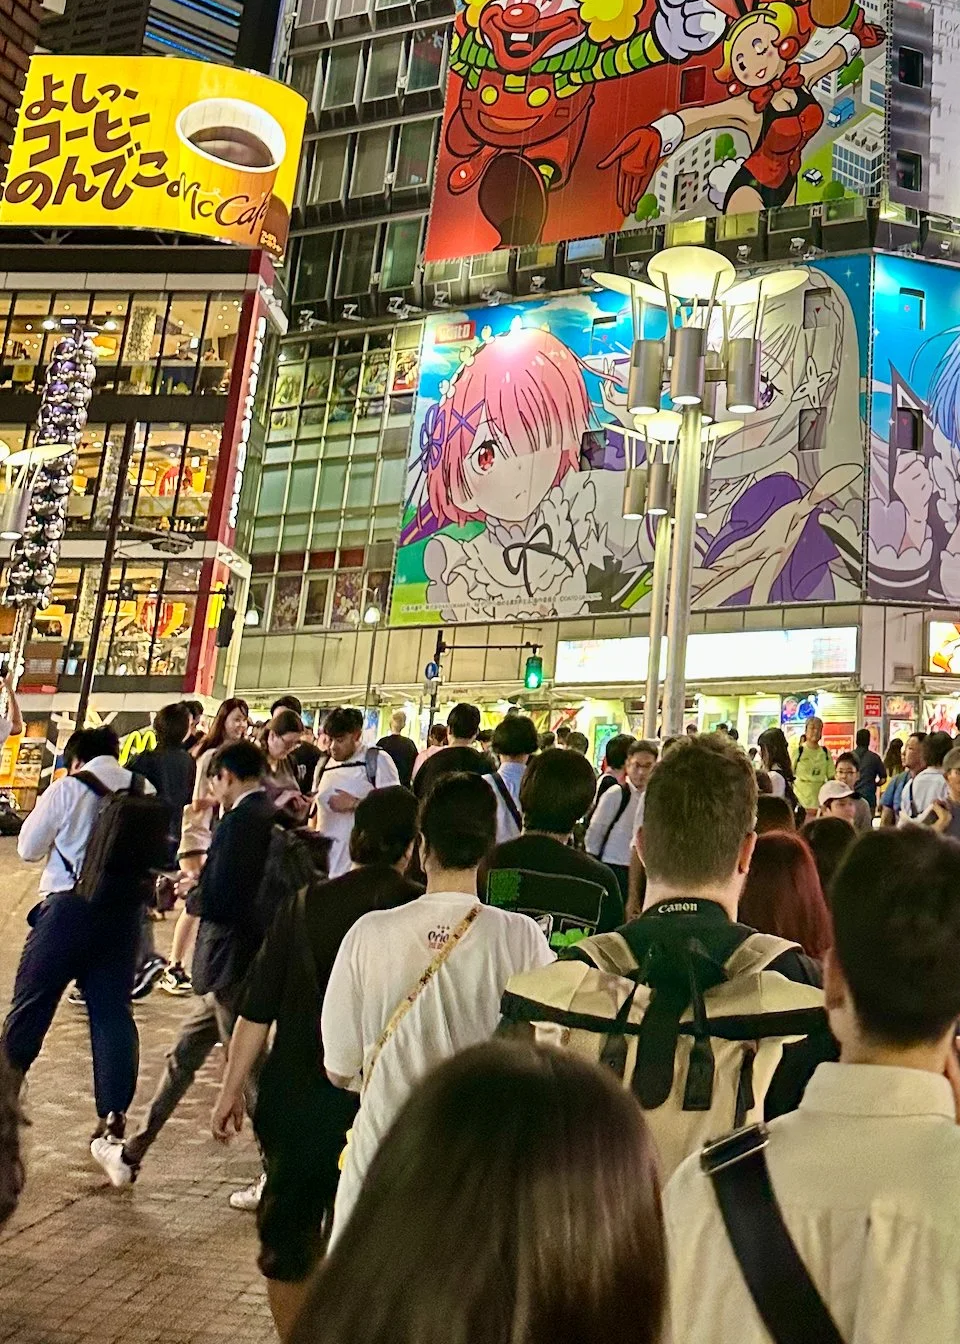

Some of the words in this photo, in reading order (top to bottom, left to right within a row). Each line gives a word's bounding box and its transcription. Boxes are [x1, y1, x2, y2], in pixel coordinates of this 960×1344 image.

[23, 110, 151, 168] コーヒー
[657, 902, 698, 914] Canon
